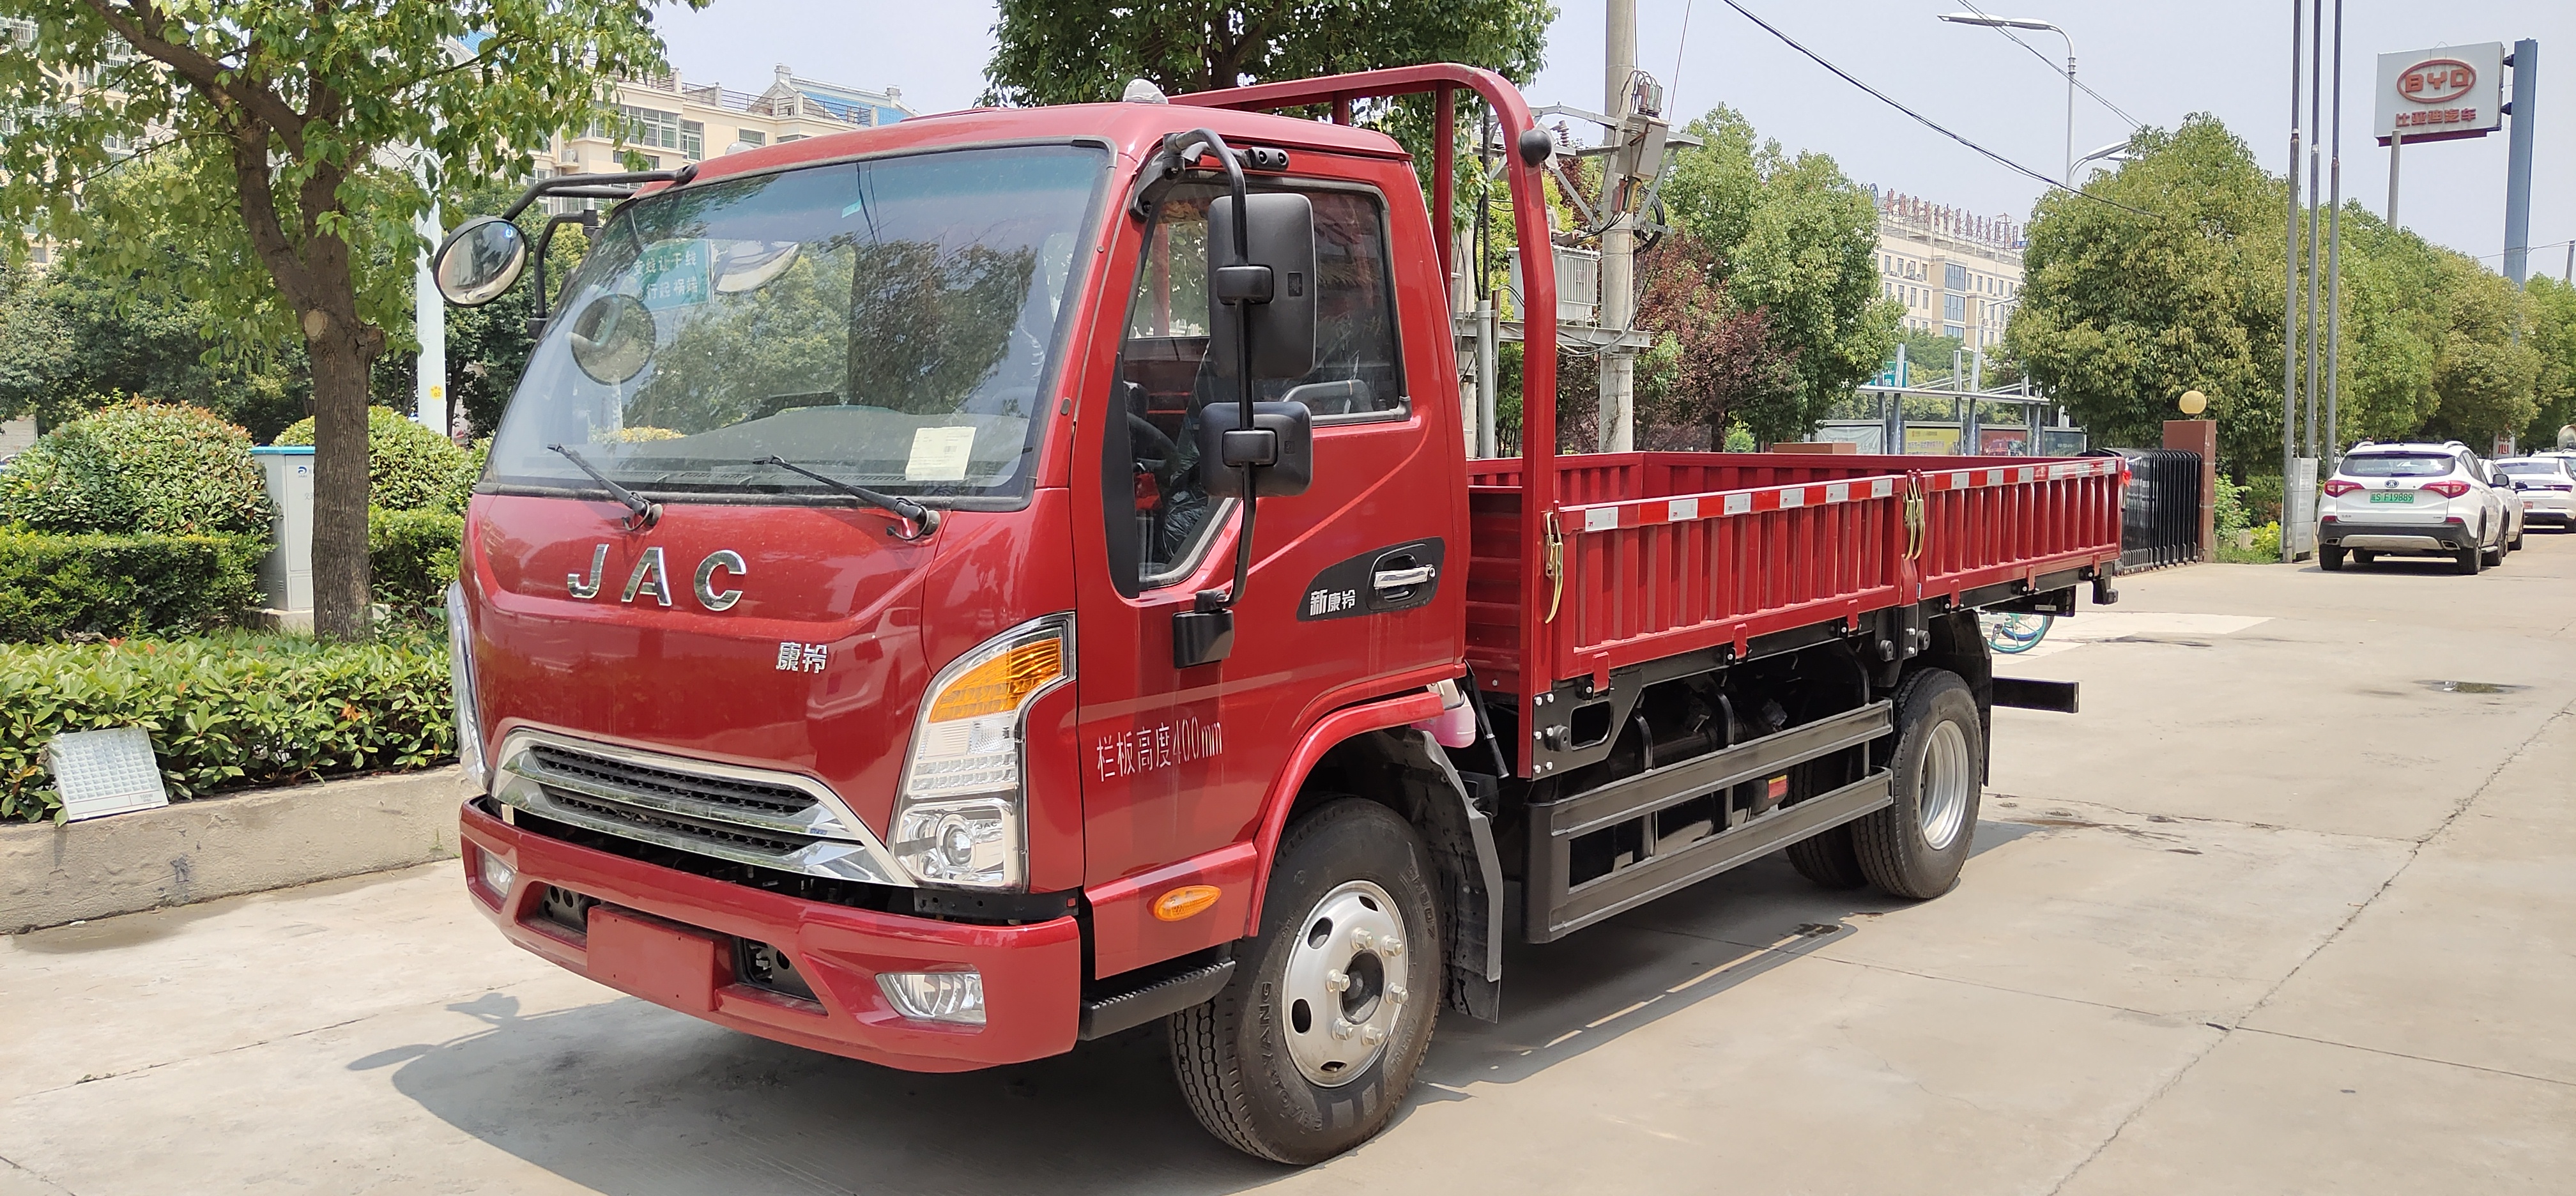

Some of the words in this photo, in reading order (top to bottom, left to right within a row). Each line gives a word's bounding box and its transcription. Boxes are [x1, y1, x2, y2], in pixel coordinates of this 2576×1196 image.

[2404, 68, 2470, 93] BYD
[2395, 107, 2476, 127] 比亚迪汽车
[633, 250, 697, 276] 支线让干线
[567, 543, 748, 612] JAC
[1310, 588, 1356, 617] 新康铃
[775, 641, 828, 675] 康铃
[1096, 715, 1223, 783] 栏板高度400mm
[977, 821, 998, 829] JAC
